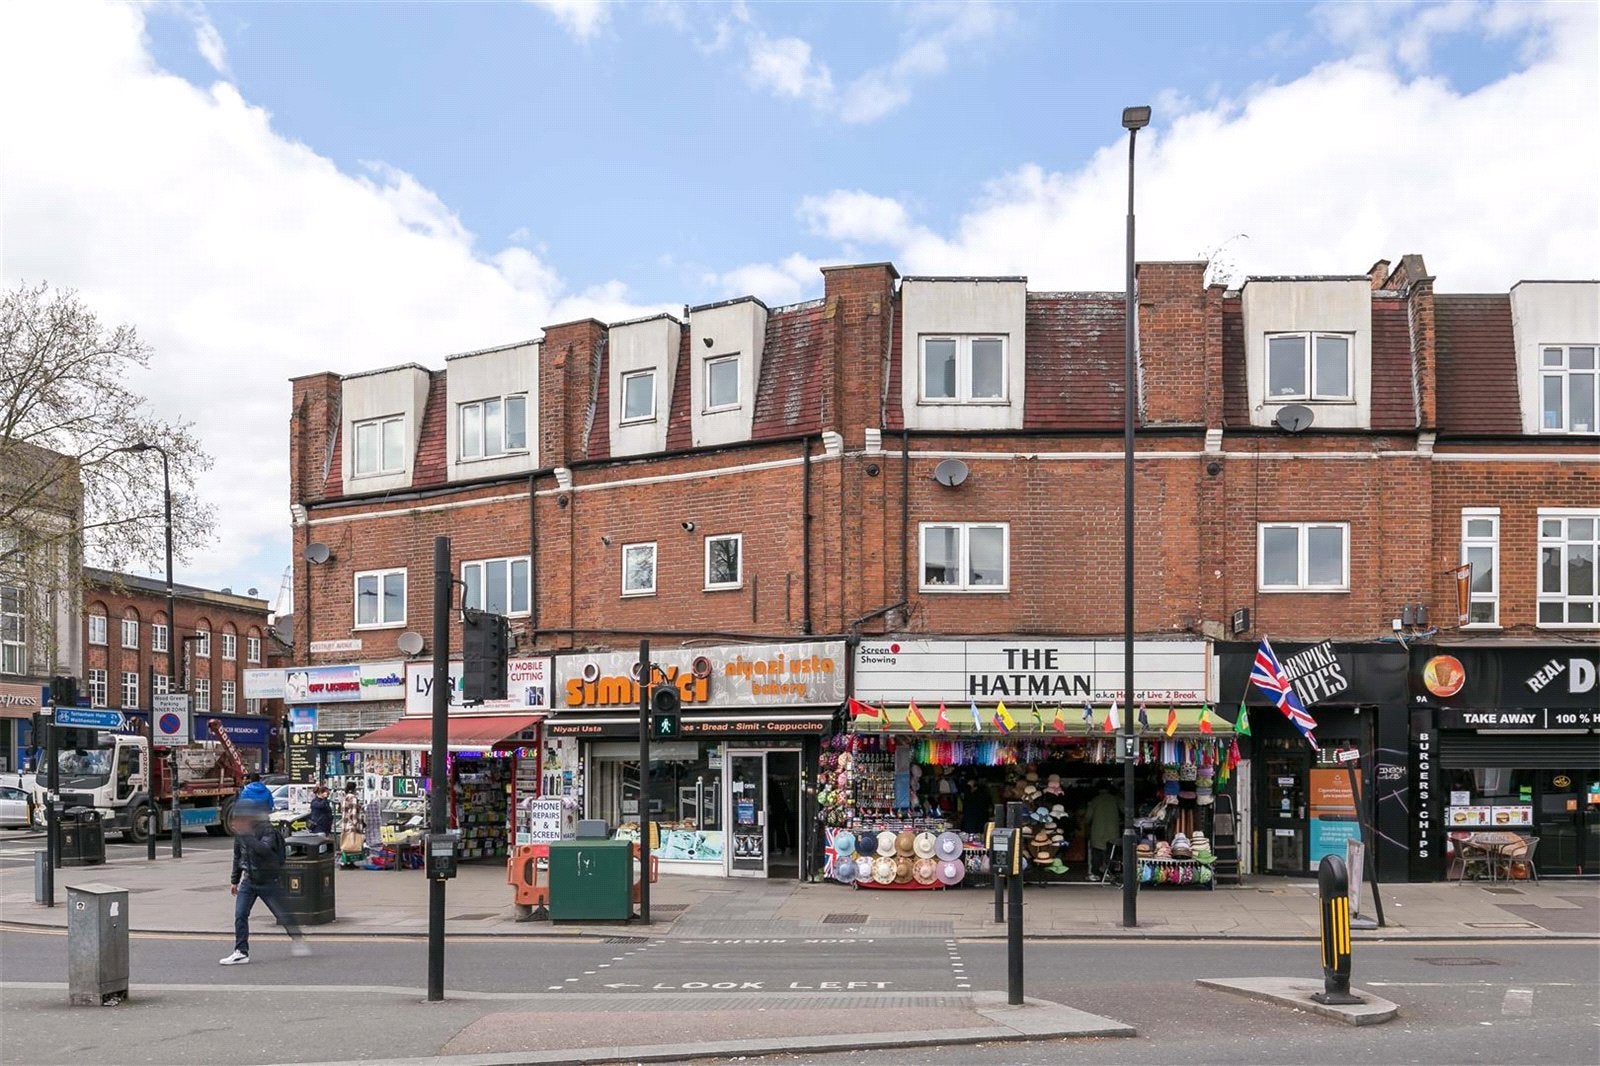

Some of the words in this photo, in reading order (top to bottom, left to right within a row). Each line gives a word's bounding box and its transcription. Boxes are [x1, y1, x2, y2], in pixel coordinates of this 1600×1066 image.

[861, 645, 890, 655] Screen
[861, 655, 897, 665] Showing
[1002, 648, 1059, 670] THE
[1283, 641, 1337, 681] RNPIKE
[515, 661, 543, 671] MOBILE
[725, 653, 785, 681] niyazi
[789, 655, 834, 674] usta
[510, 672, 544, 682] CUTTING
[1526, 659, 1566, 693] REAL
[1569, 658, 1600, 694] D
[309, 683, 325, 693] OFF
[416, 674, 456, 696] Lya
[752, 681, 807, 698] bakery
[969, 674, 1092, 697] HATMAN
[1294, 662, 1348, 707] APES
[1095, 691, 1115, 699] a.k.a
[1137, 690, 1146, 699] of
[1147, 690, 1163, 699] Live
[1166, 690, 1172, 699] 2
[1174, 690, 1197, 699] Break
[1416, 695, 1428, 703] 9A
[0, 693, 38, 708] xpress
[1463, 713, 1497, 723] TAKE
[1499, 713, 1537, 723] AWAY
[1555, 714, 1577, 723] 100
[1579, 714, 1590, 723] %
[553, 725, 580, 734] Niyazi
[702, 723, 728, 731] Bread
[736, 722, 760, 730] Simit
[767, 721, 823, 731] Cappuccino
[1419, 733, 1430, 799] BURGERS
[532, 802, 560, 811] PHONE
[543, 821, 549, 829] &
[532, 830, 560, 839] SCREEN
[1419, 811, 1430, 858] CHIPS
[652, 981, 765, 989] LOOK
[789, 981, 894, 989] LEFT
